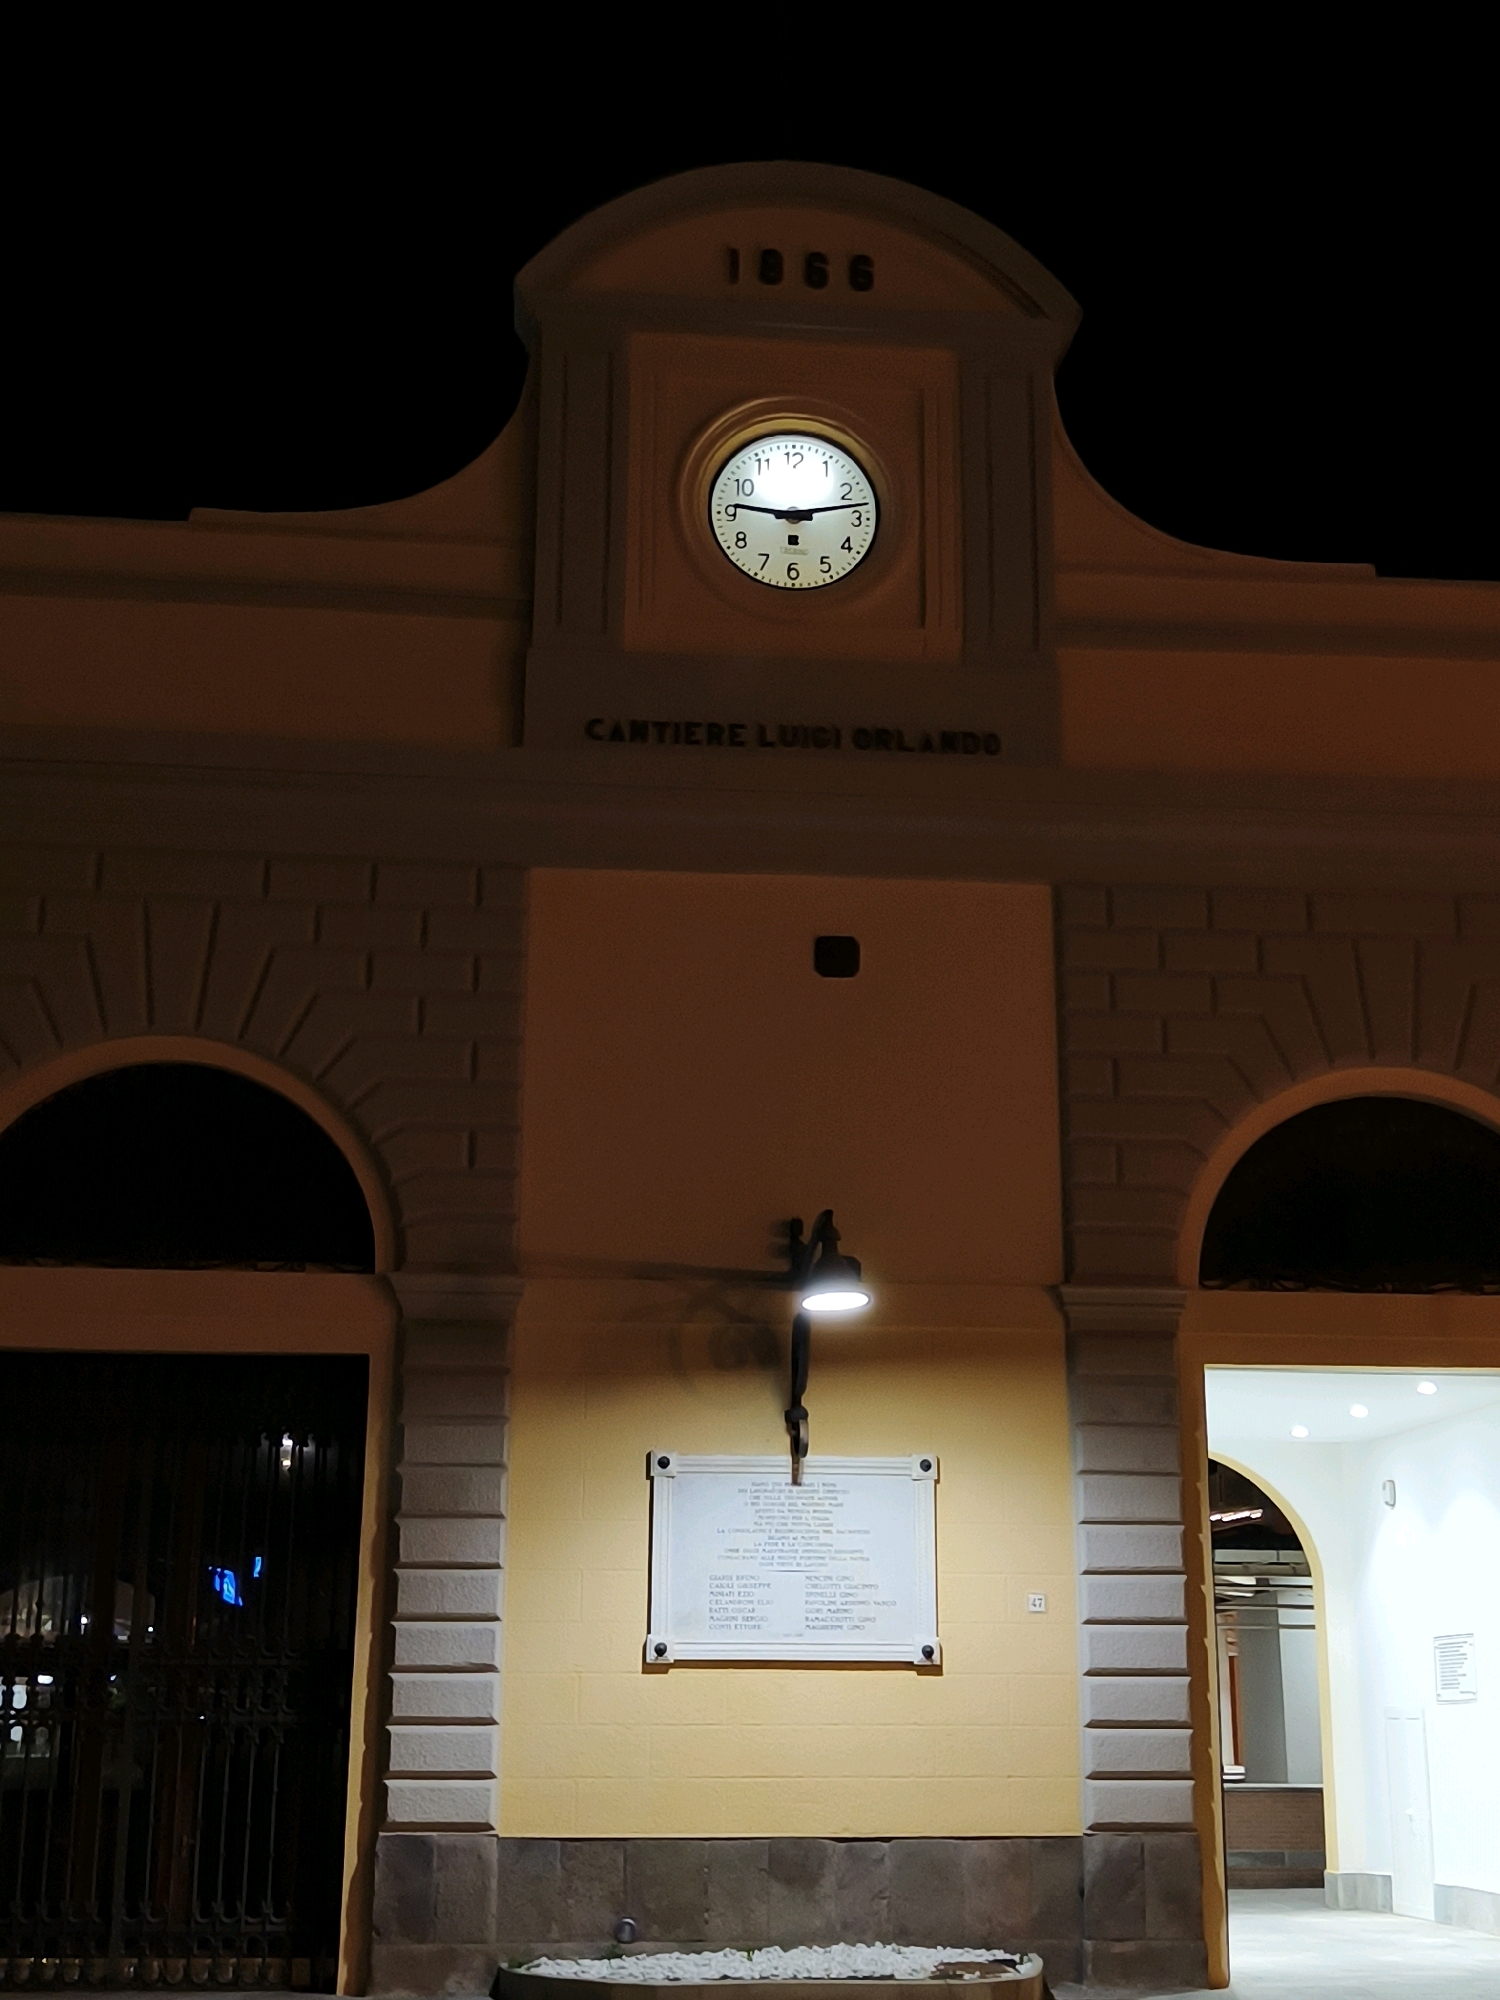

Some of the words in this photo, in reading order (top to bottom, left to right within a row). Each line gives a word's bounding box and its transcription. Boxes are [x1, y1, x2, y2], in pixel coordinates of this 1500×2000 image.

[727, 248, 875, 293] 1866
[755, 458, 770, 476] 11
[784, 452, 804, 470] 12
[822, 460, 829, 478] 1
[734, 478, 754, 497] 10
[840, 482, 853, 501] 2
[724, 504, 737, 521] 9
[851, 510, 862, 527] 3
[735, 531, 748, 549] 8
[840, 536, 853, 553] 4
[758, 553, 770, 571] 7
[786, 562, 800, 580] 6
[819, 556, 832, 573] 5
[584, 718, 747, 747] CANTIERE
[758, 723, 842, 750] LUIGI
[851, 727, 1001, 756] ORLANDO
